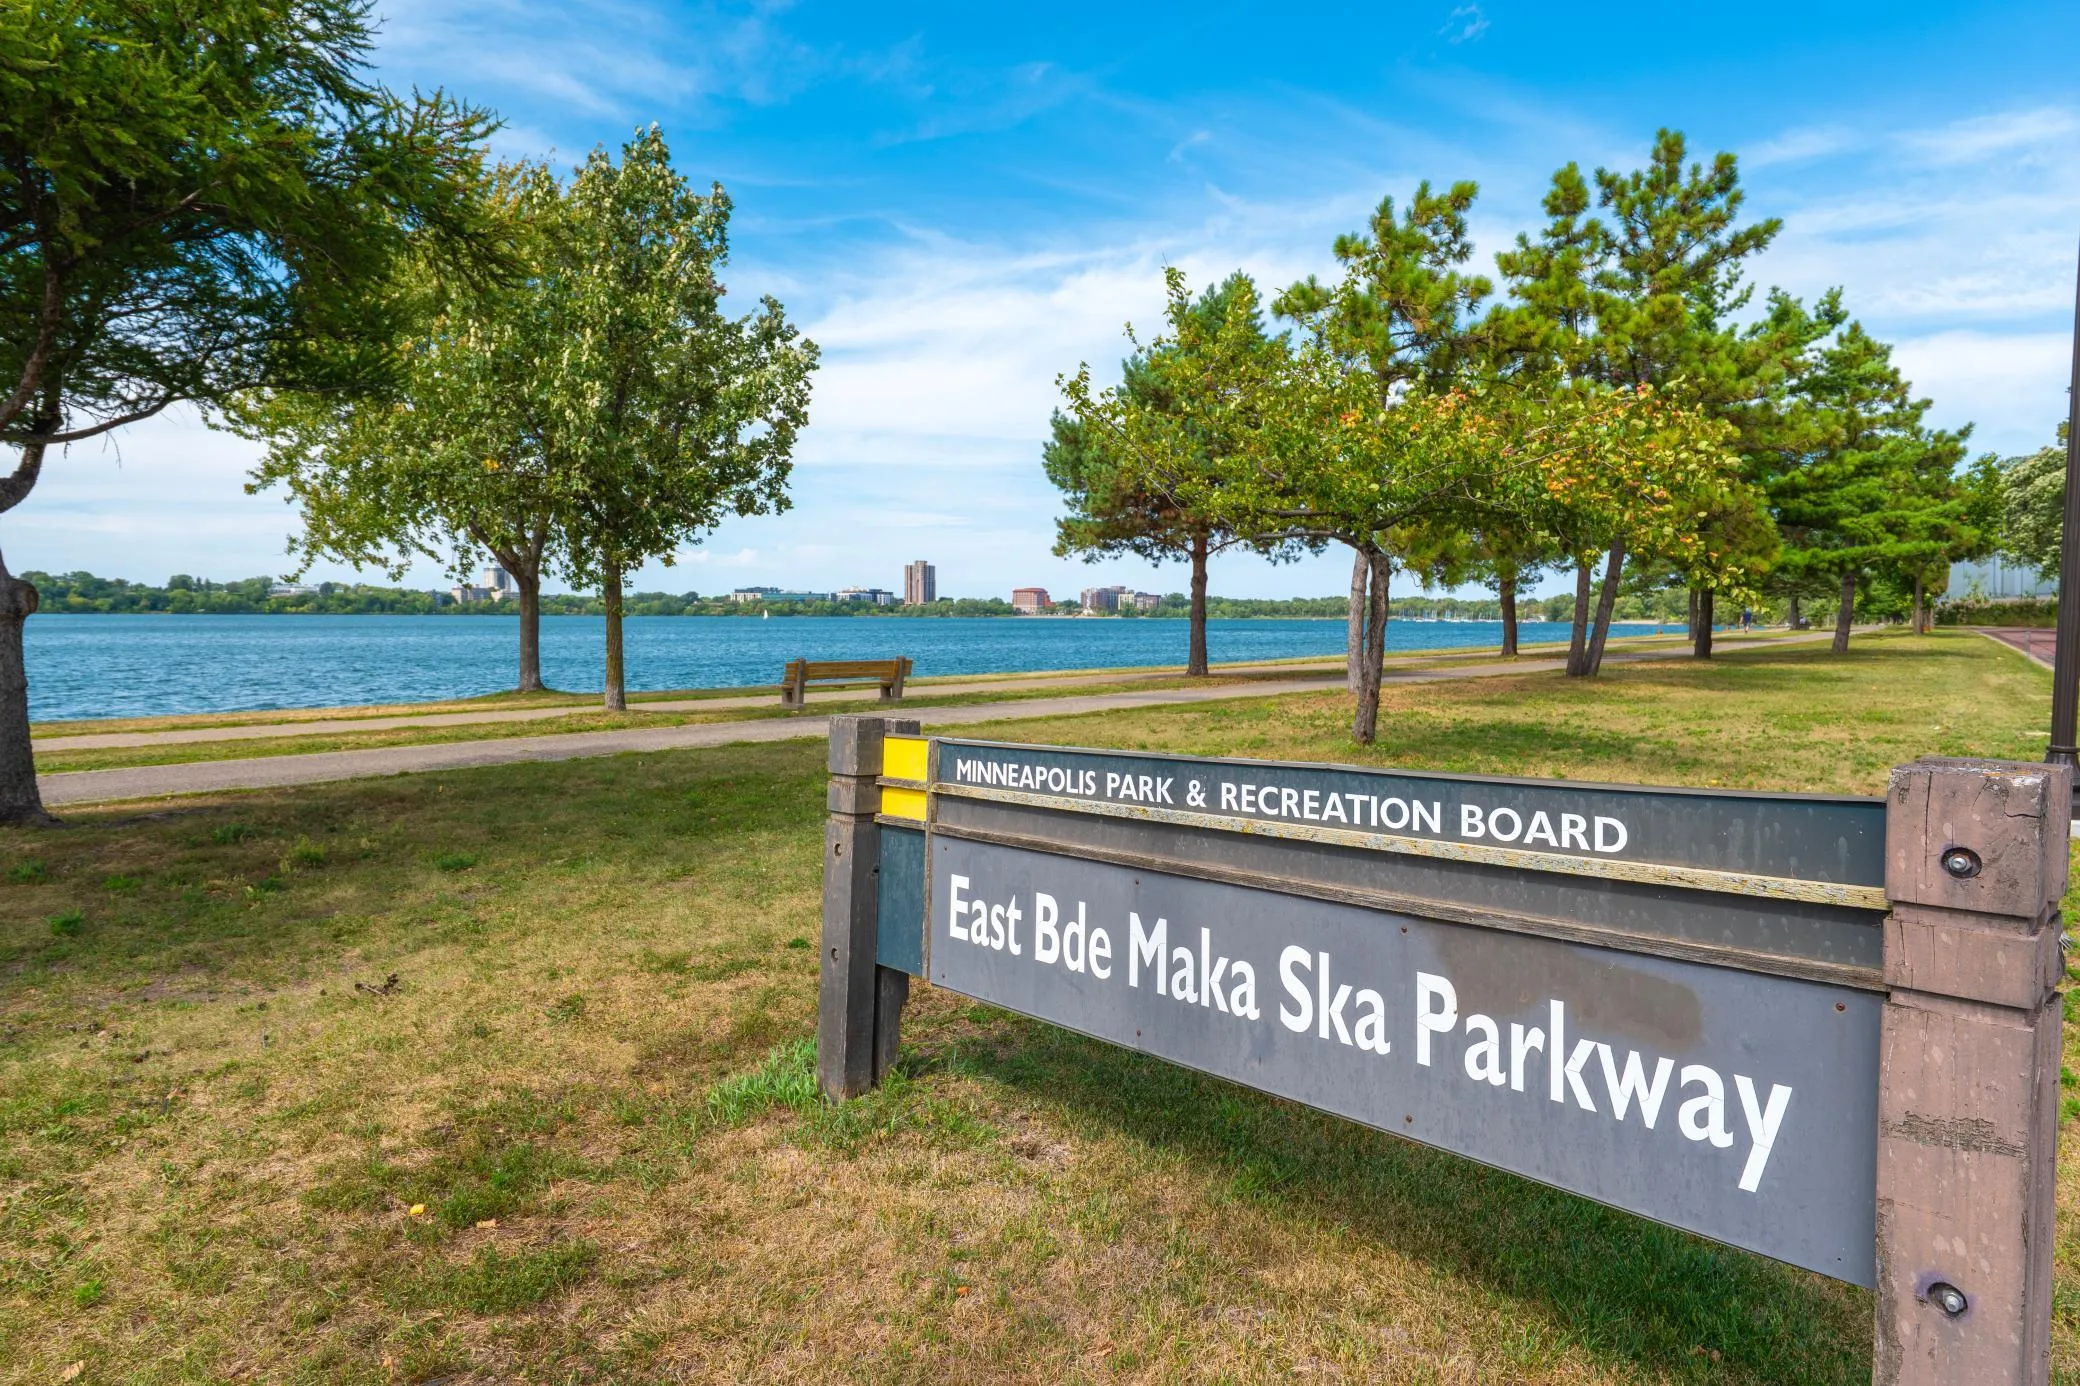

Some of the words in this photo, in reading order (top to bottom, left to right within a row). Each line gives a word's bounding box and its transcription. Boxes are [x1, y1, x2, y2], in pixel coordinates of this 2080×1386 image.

[956, 758, 1097, 796] MINNEAPOLIS
[1106, 772, 1174, 805] PARK
[1186, 779, 1207, 808] &
[1221, 782, 1441, 834] RECREATION
[1460, 803, 1628, 853] BOARD
[949, 873, 1023, 956] East
[1034, 891, 1112, 980] Bde
[1128, 911, 1261, 1021] Maka
[1279, 944, 1391, 1056] Ska
[1416, 971, 1793, 1193] Parkway
